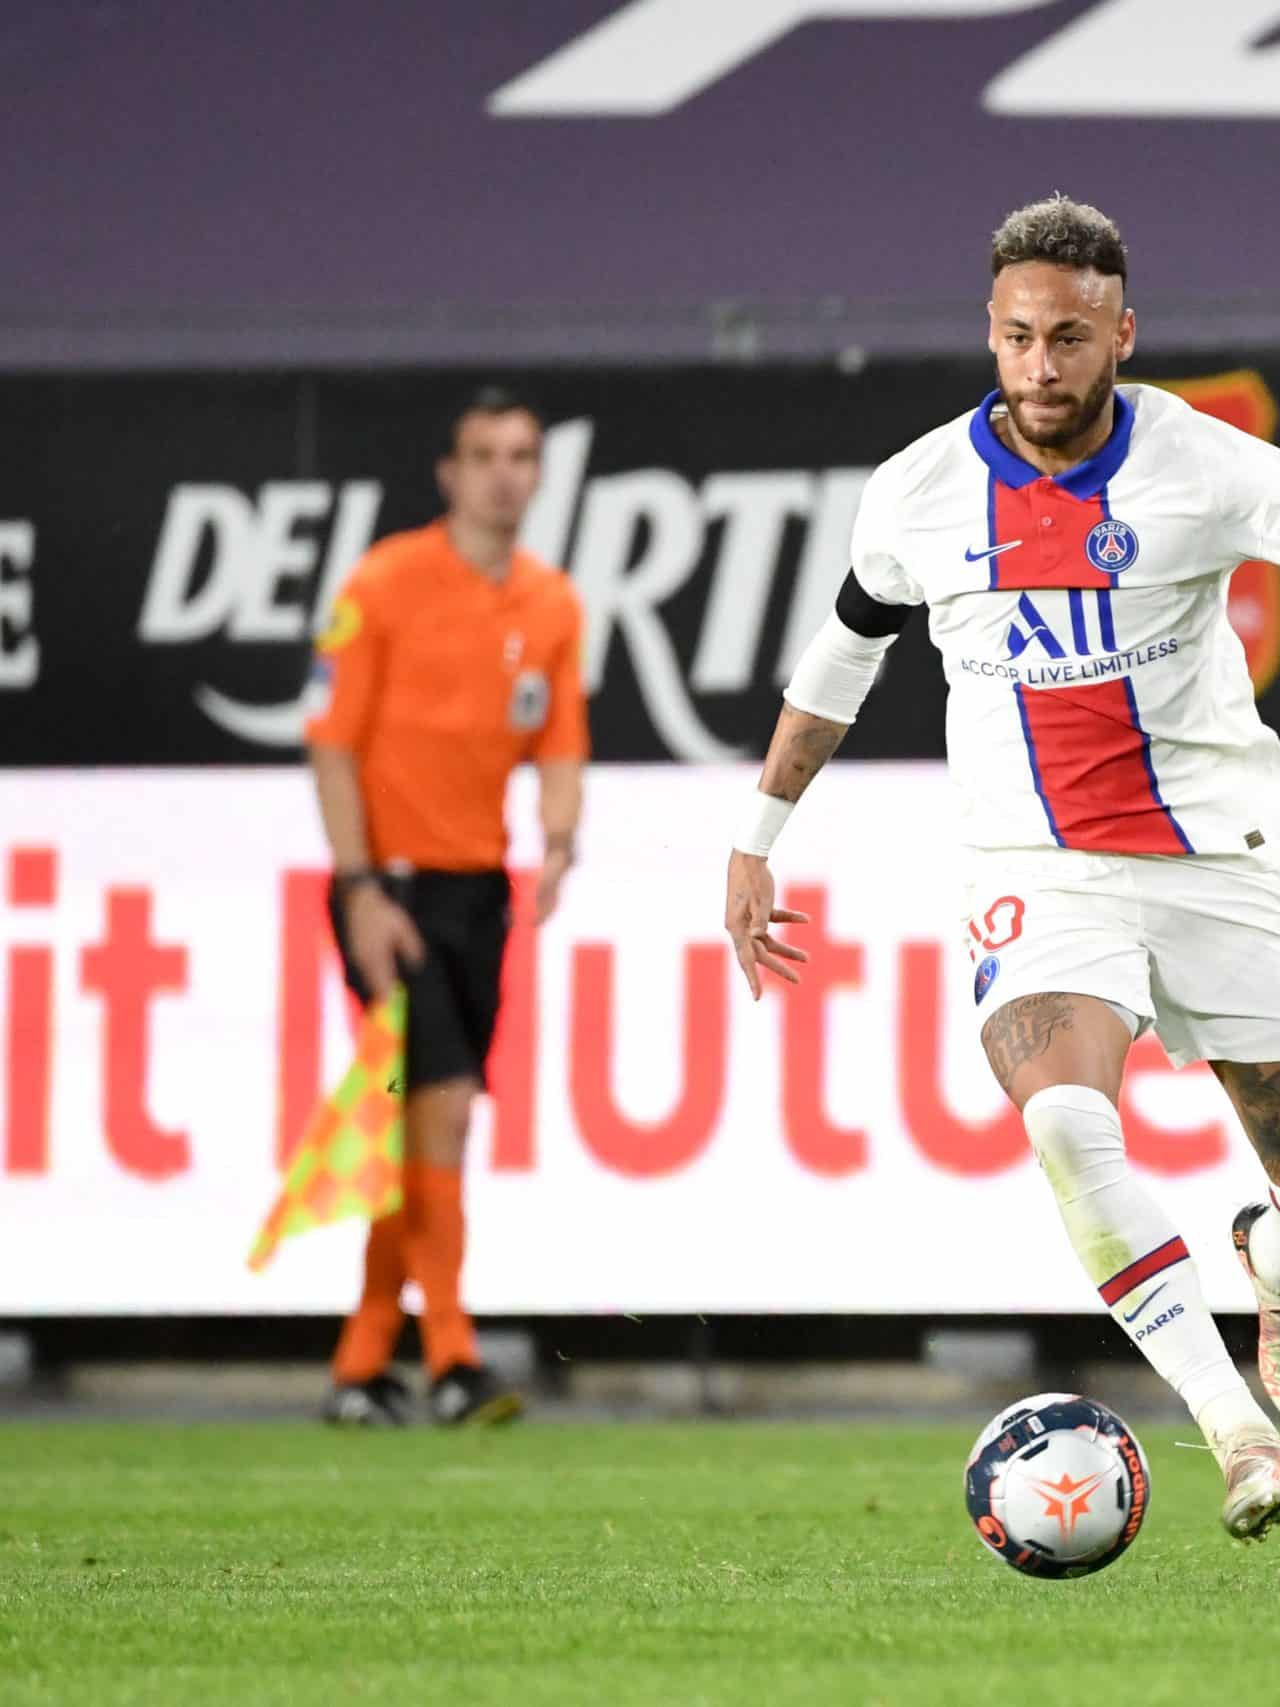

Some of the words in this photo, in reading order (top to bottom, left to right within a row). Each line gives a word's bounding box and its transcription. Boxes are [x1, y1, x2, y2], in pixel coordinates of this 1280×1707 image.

[1093, 523, 1127, 538] PARIS
[961, 657, 1020, 681] ACCOR
[1027, 664, 1074, 685] LIVE
[1080, 638, 1178, 680] LIMITLESS
[4, 845, 192, 1182] it
[1135, 1303, 1185, 1341] PARIS
